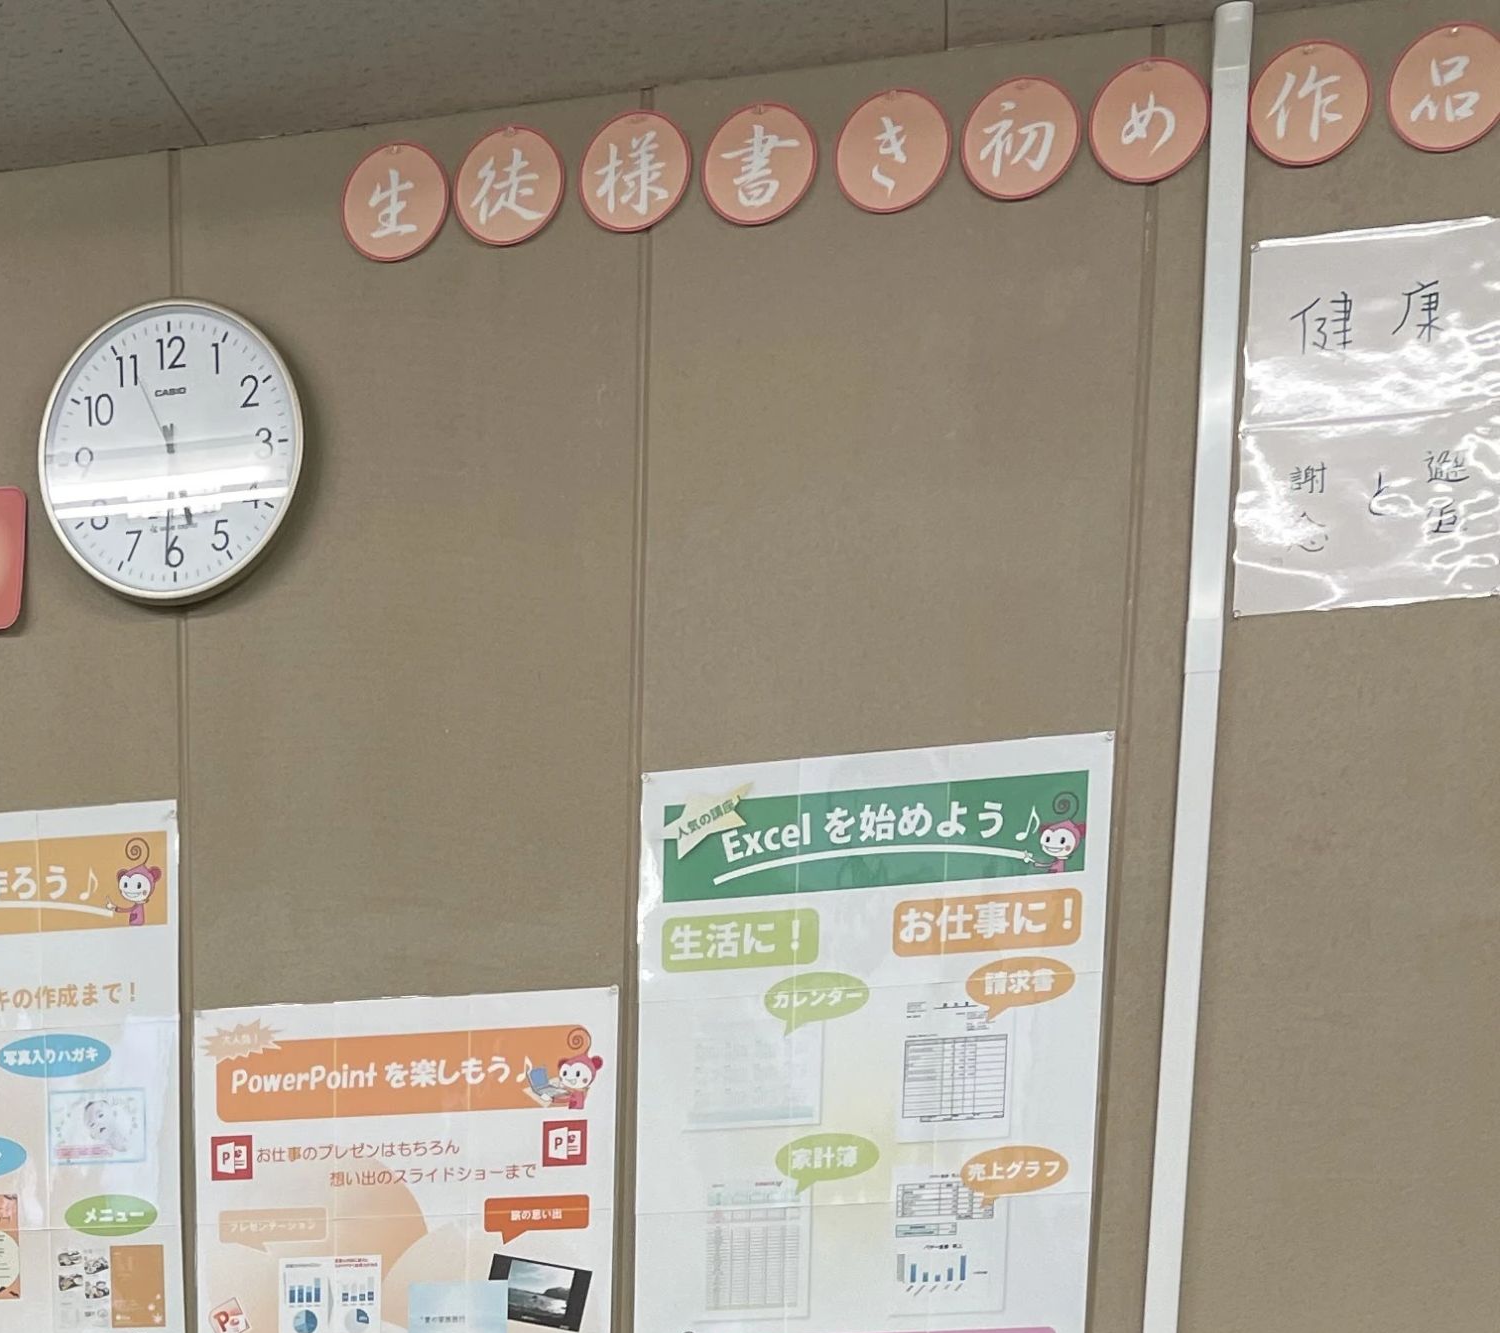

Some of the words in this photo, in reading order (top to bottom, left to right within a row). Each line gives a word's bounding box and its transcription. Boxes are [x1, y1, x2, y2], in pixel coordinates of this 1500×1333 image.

[370, 52, 1476, 237] 生徒様書き初め作品
[156, 336, 186, 370] 12
[116, 355, 138, 388] 11
[155, 388, 187, 397] CASIO
[240, 375, 260, 408] 2
[84, 394, 114, 427] 10
[255, 428, 273, 459] 3
[126, 530, 142, 562] 7
[211, 520, 230, 551] 5
[166, 536, 185, 568] 6
[721, 821, 811, 863] Excel
[824, 801, 1005, 845] を始めよう
[900, 898, 1074, 943] お仕事に!
[669, 921, 801, 961] 生活に!
[984, 969, 1056, 994] 請求書
[773, 987, 863, 1009] カレンダー
[2, 1047, 100, 1067] 写真入りハガキ
[231, 1062, 376, 1095] PowerPoint
[384, 1056, 512, 1089] を楽しもう
[256, 1140, 461, 1163] お仕事のプレゼンはもちろん
[791, 1146, 858, 1170] 家計簿
[329, 1163, 538, 1188] 想い出のスライドショーまで
[968, 1158, 1061, 1182] 売上グラフ
[83, 1207, 146, 1224] メニュー
[228, 1218, 317, 1233] プレゼンテーション
